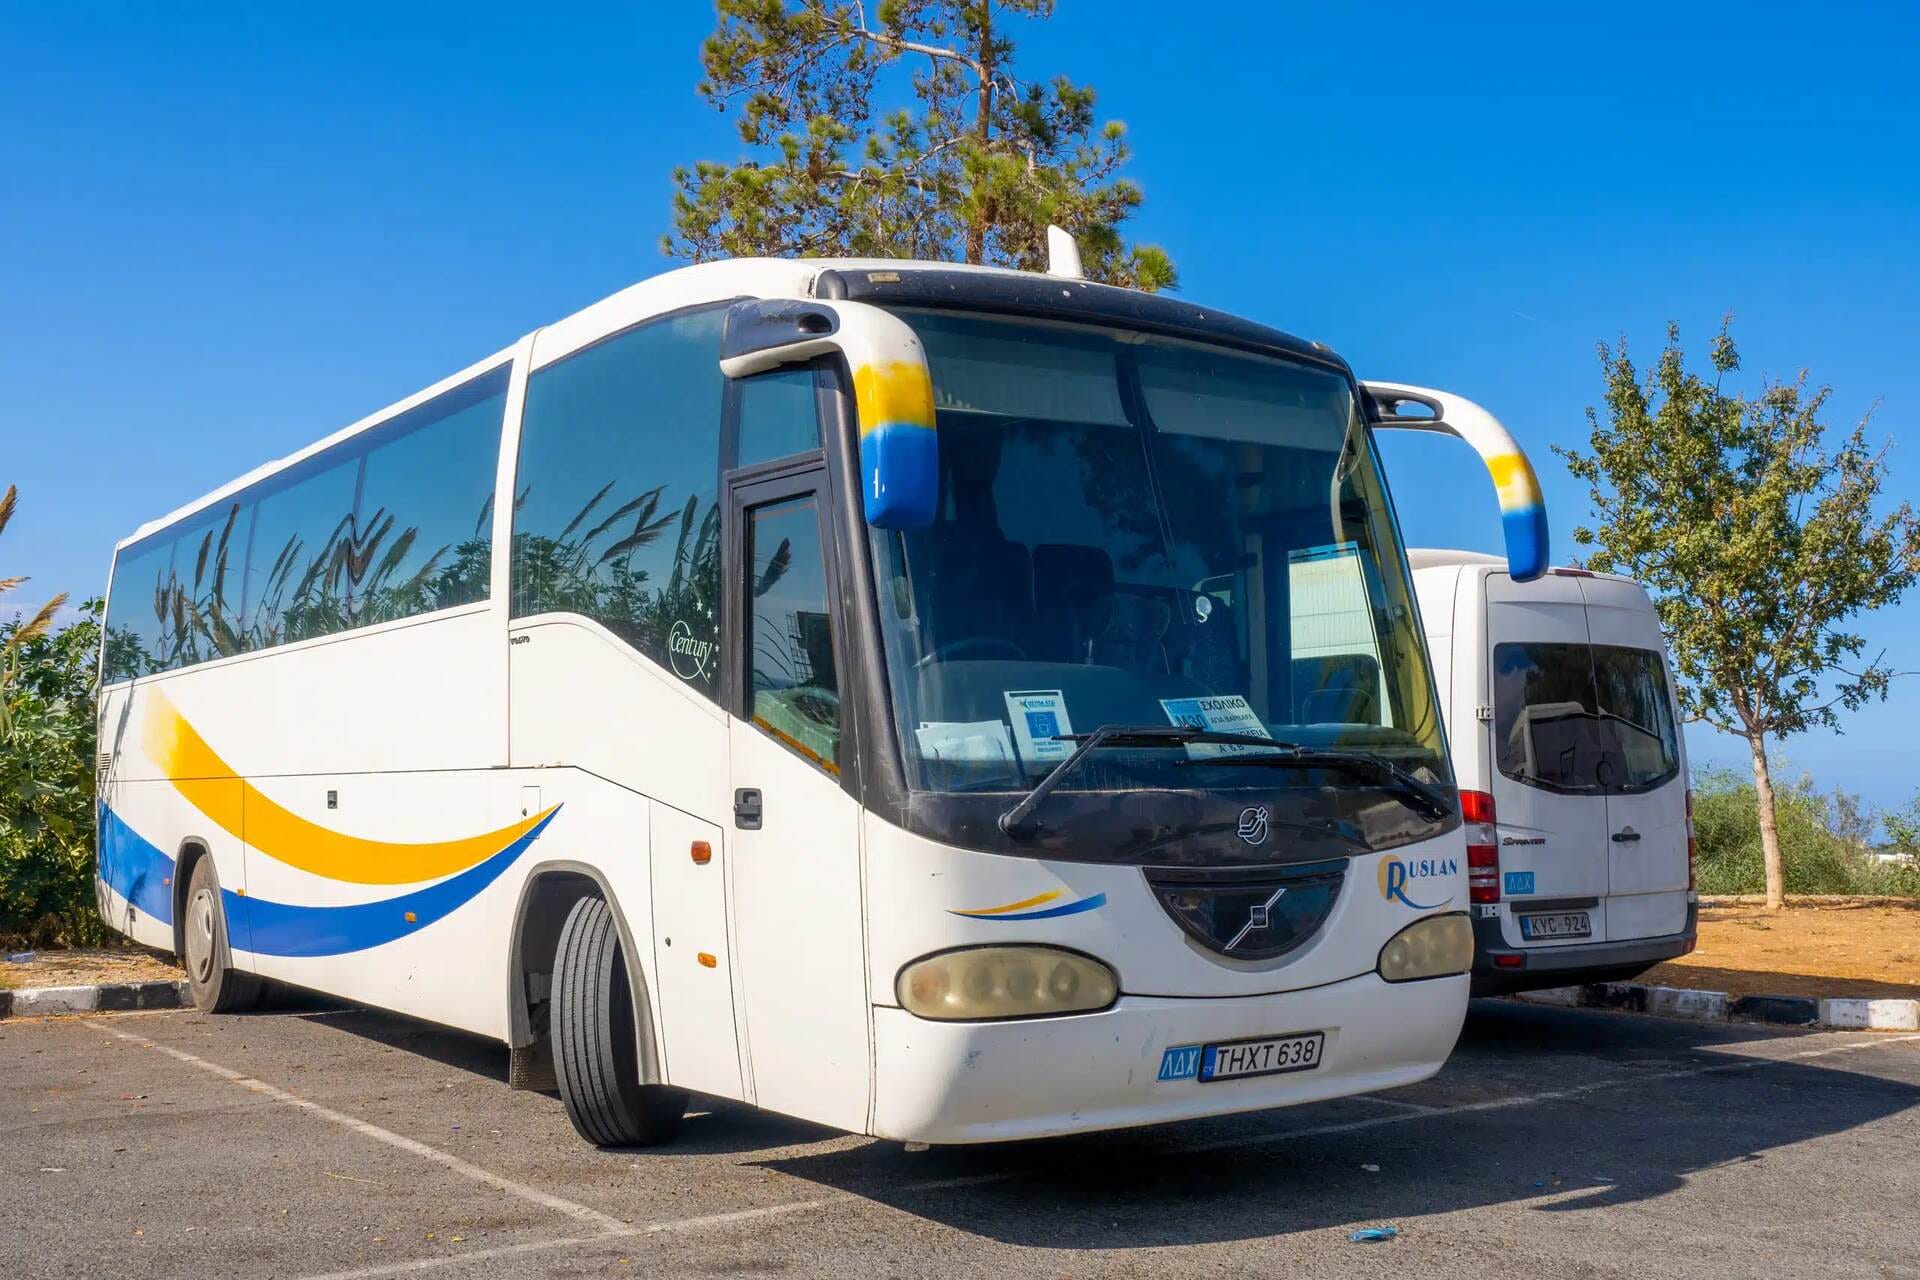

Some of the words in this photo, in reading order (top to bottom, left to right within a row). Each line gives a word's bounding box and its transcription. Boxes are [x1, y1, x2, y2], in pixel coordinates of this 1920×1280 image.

[671, 631, 713, 660] Century
[1200, 698, 1245, 710] ΣΧΟΛΙΚΟ
[1386, 858, 1457, 907] RUSLAN
[1532, 917, 1557, 935] KYC
[1564, 915, 1587, 931] 924
[1217, 1045, 1275, 1073] THXT
[1276, 1039, 1316, 1066] 638
